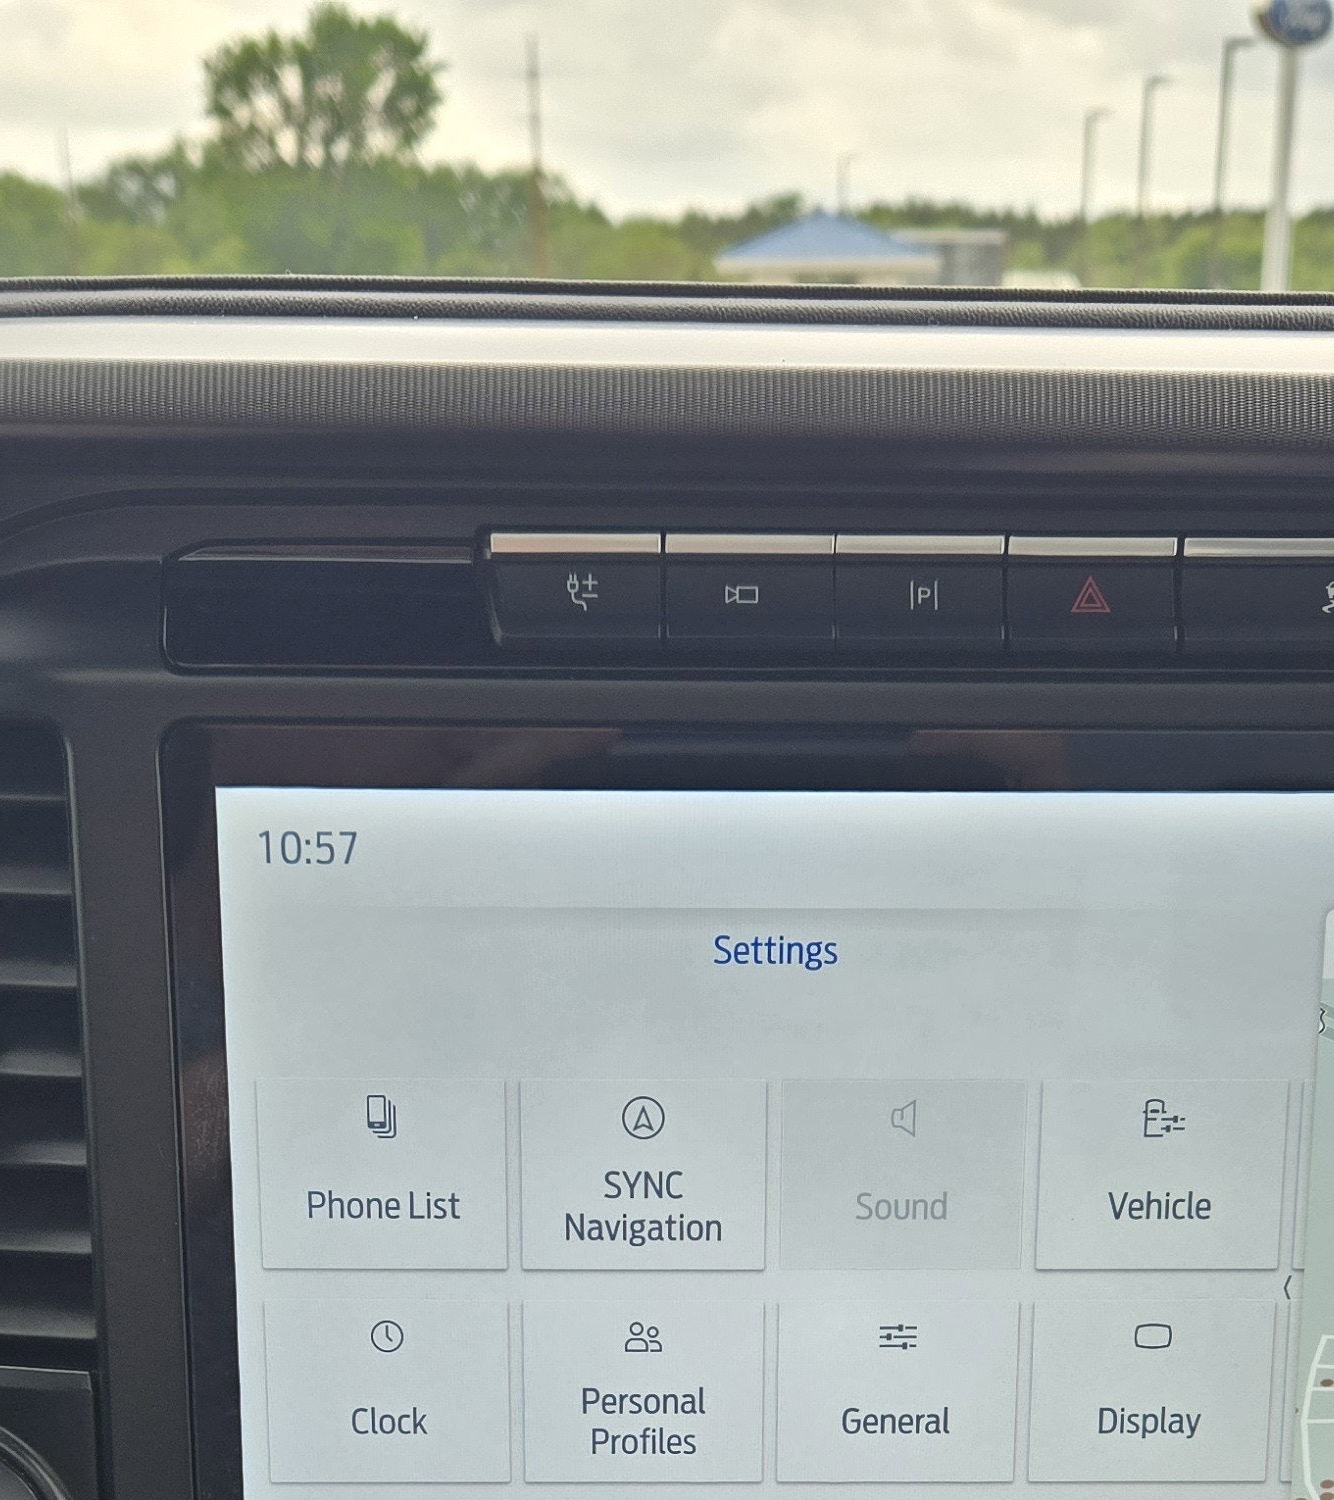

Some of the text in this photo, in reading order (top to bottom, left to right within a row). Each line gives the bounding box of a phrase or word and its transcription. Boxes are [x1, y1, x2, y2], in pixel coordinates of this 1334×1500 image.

[258, 830, 357, 866] 10:57
[713, 933, 839, 971] Settings
[603, 1170, 684, 1200] SYNC
[307, 1190, 461, 1220] Phone List
[854, 1192, 949, 1222] Sound
[1109, 1190, 1212, 1223] Vehicle
[565, 1213, 723, 1247] Navigation
[581, 1386, 706, 1416] Personal
[351, 1406, 428, 1436] Clock
[841, 1406, 949, 1436] General
[1097, 1406, 1202, 1440] Display
[590, 1428, 697, 1457] Profiles
